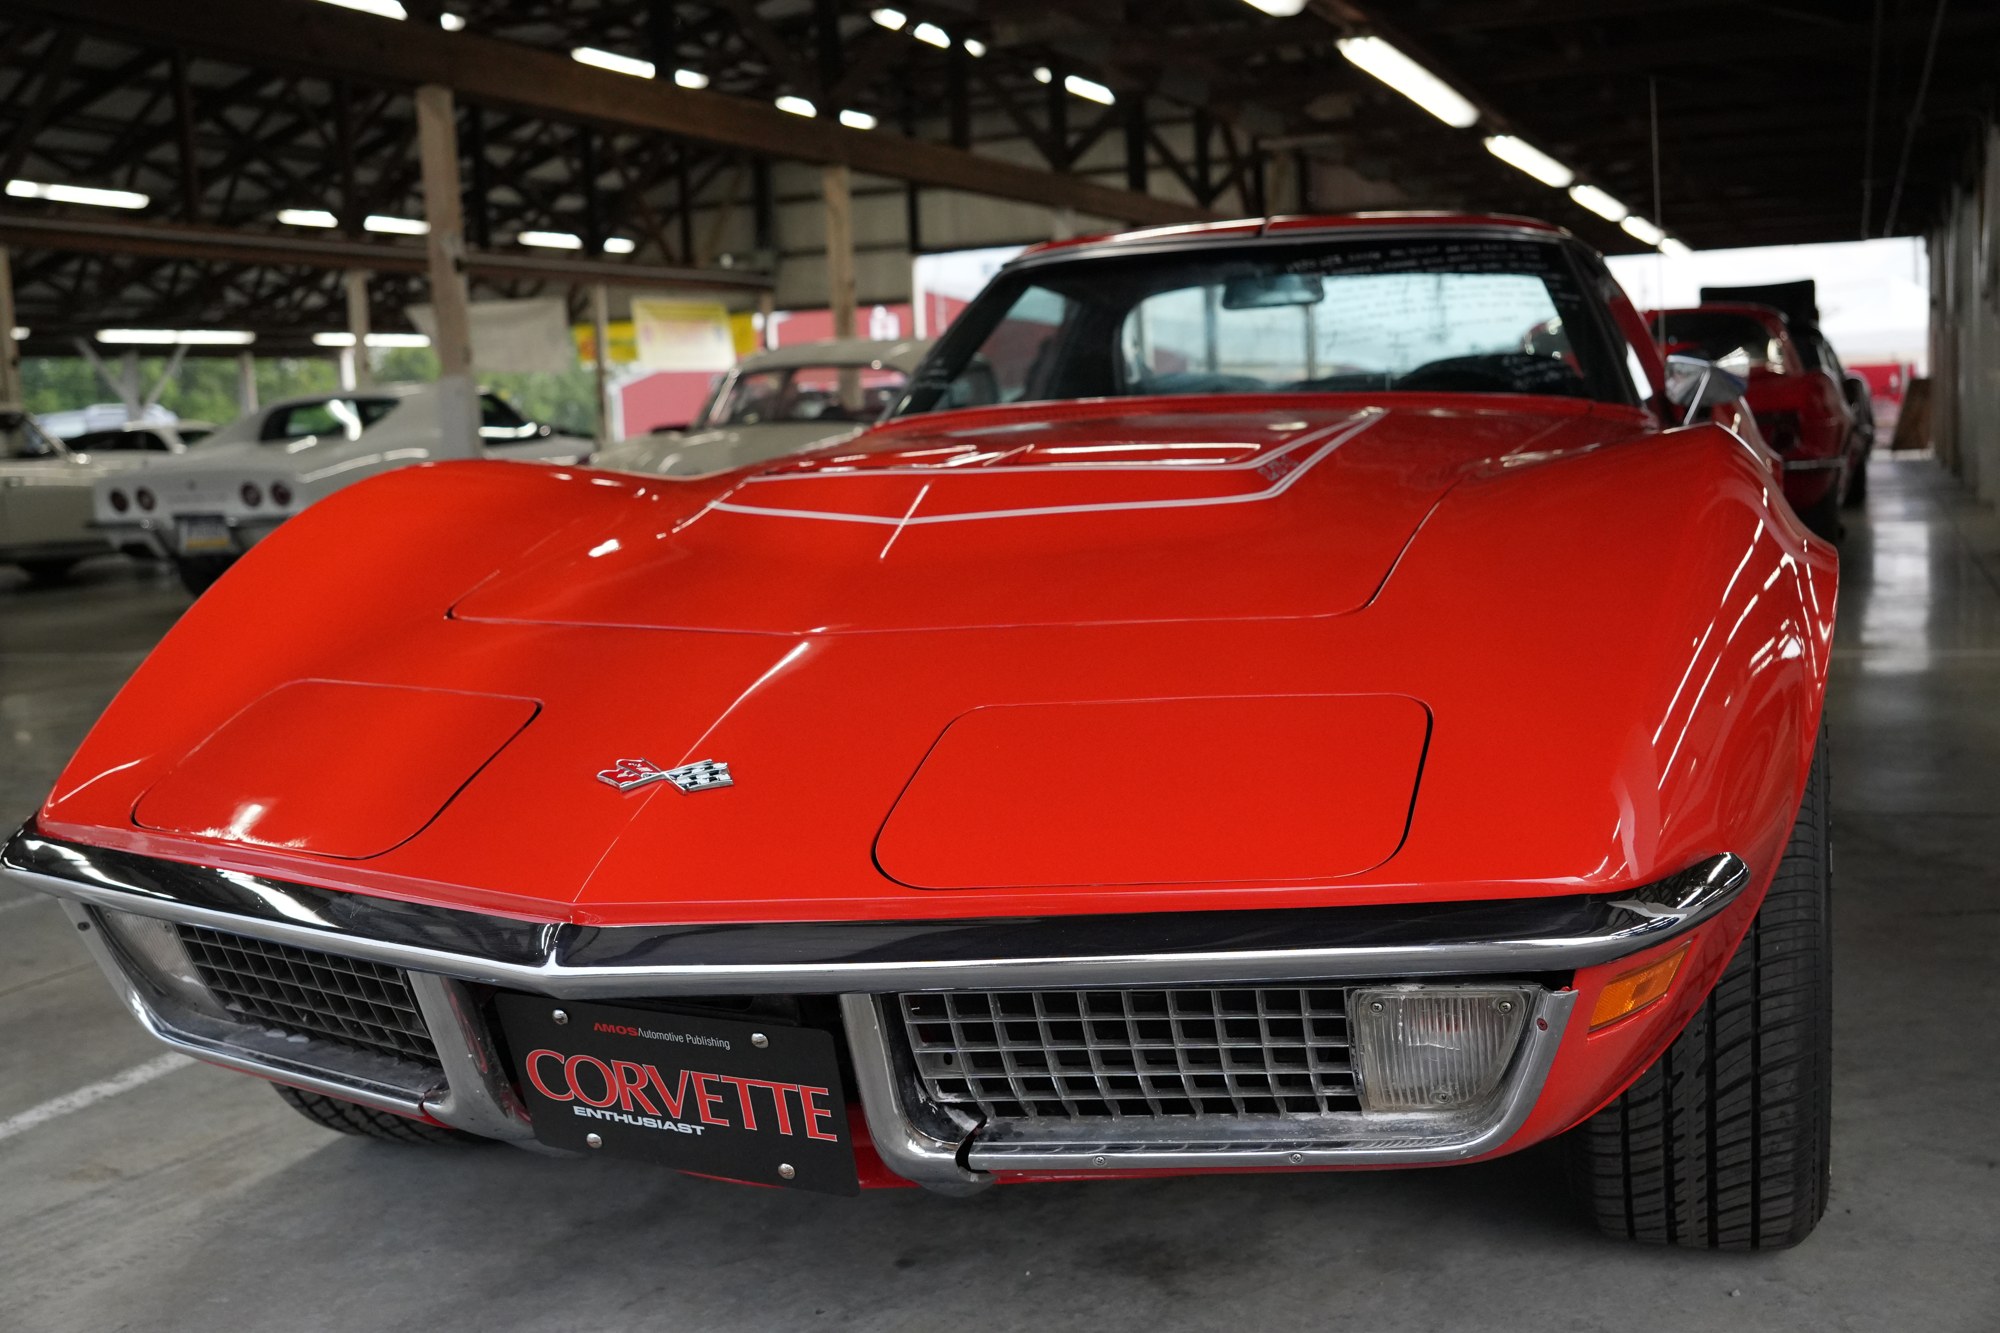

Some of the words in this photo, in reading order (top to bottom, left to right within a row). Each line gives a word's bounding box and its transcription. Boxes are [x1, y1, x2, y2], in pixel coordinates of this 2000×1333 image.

[685, 1033, 731, 1050] Publishing
[525, 1049, 838, 1142] CORVETTE
[573, 1105, 705, 1135] ENTHUSIAST
